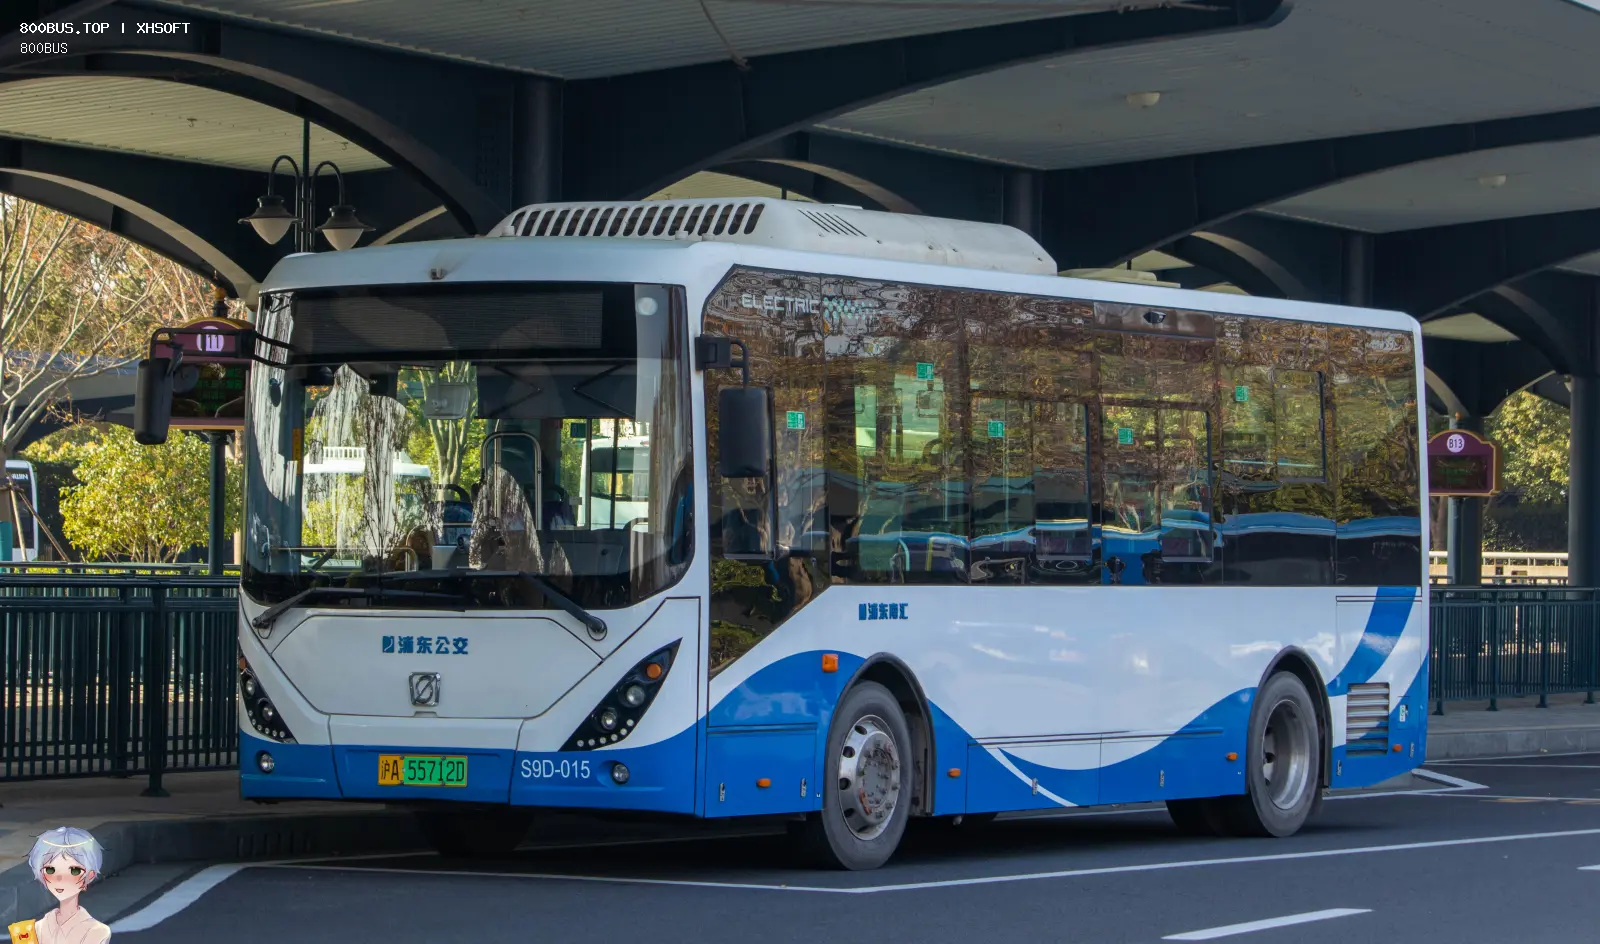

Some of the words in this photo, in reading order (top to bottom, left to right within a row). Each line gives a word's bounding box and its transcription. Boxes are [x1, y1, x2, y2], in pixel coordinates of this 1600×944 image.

[741, 293, 820, 314] ELECTRIC
[1448, 438, 1463, 449] B13
[397, 635, 469, 655] 浦东公交
[520, 759, 591, 779] S9D-015
